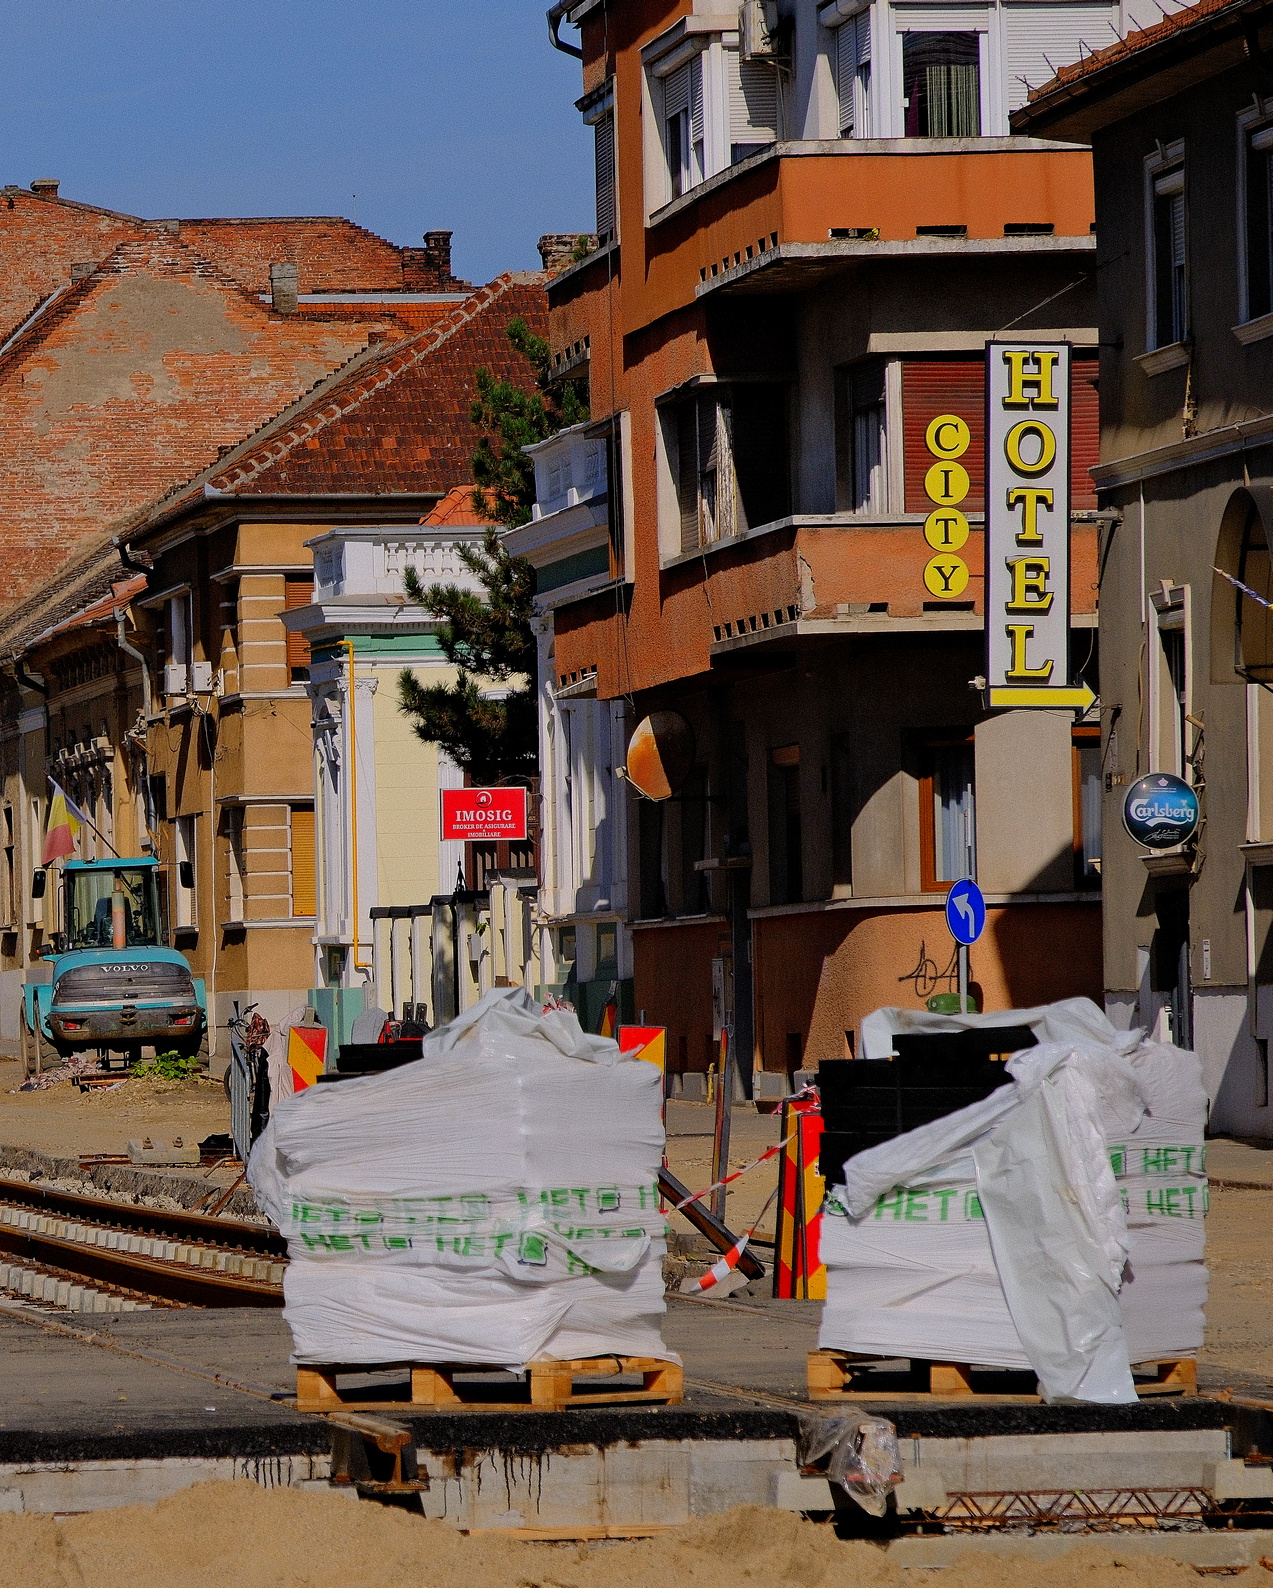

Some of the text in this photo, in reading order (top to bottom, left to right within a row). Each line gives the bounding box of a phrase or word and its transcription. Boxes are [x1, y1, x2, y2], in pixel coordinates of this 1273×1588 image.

[933, 422, 960, 592] CITY
[1003, 350, 1059, 682] HOTEL
[455, 810, 513, 822] IMOSIG
[1130, 798, 1195, 824] Carlsberg
[100, 964, 149, 973] VOLVO
[1143, 1147, 1196, 1173] HET
[874, 1188, 959, 1222] HET
[1146, 1186, 1198, 1219] HET
[300, 1232, 372, 1252] HET
[435, 1232, 513, 1257] HET
